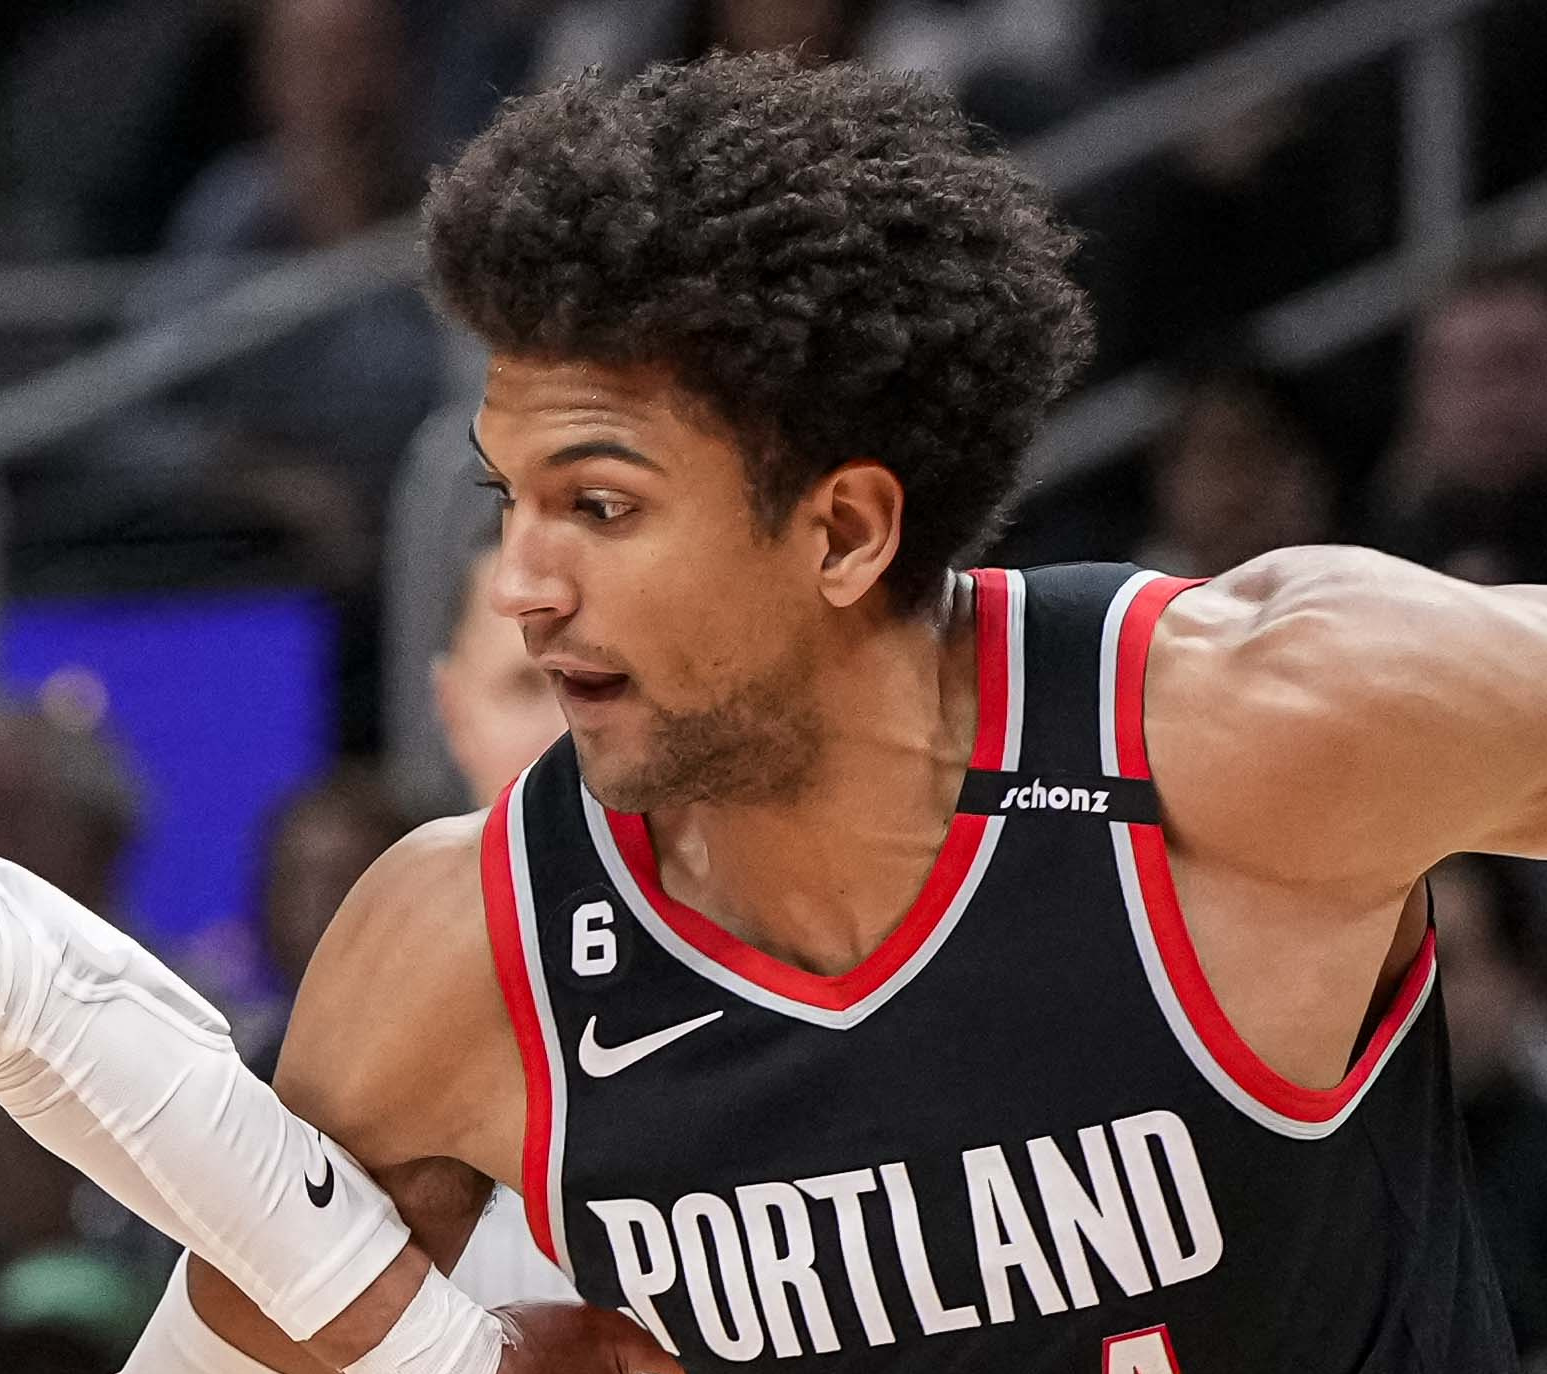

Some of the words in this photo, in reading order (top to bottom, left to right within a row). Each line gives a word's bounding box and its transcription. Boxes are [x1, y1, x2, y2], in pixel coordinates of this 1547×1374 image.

[999, 777, 1111, 814] schonz
[570, 900, 619, 977] 6
[586, 1109, 1225, 1363] PORTLAND
